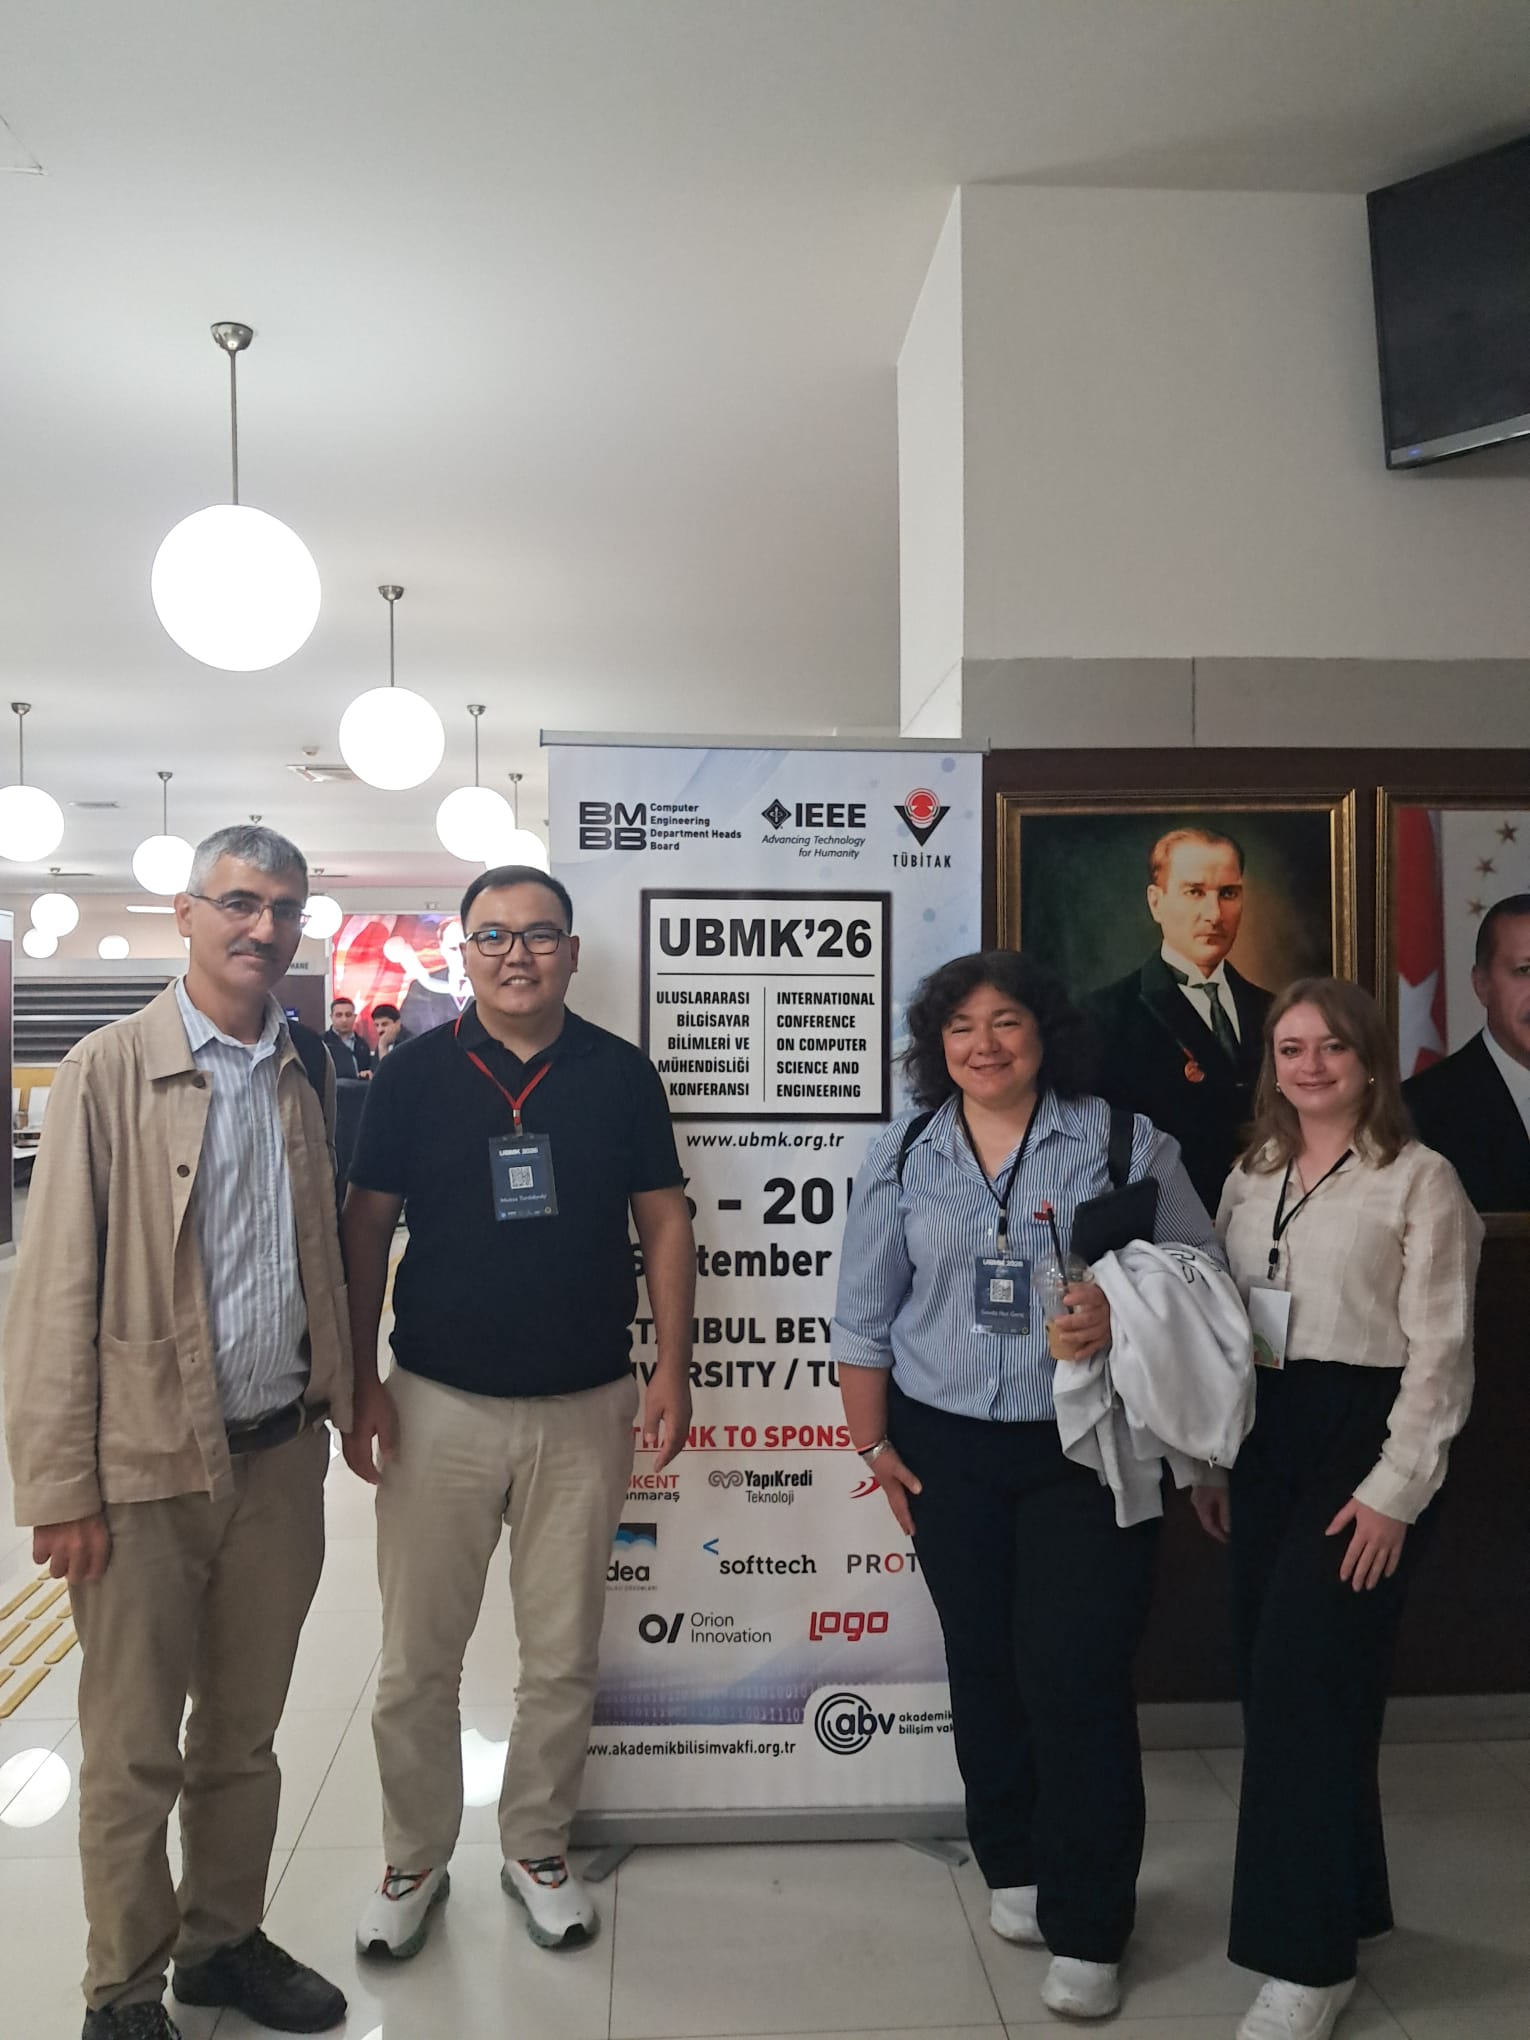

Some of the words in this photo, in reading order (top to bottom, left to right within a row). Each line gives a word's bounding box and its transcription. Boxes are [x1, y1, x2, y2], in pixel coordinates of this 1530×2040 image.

[578, 801, 647, 826] BM
[650, 803, 699, 814] Computer
[795, 803, 867, 828] IEEE
[650, 816, 710, 827] Engineering
[578, 827, 647, 850] BB
[650, 829, 709, 840] Department
[711, 830, 742, 839] Heads
[761, 835, 811, 847] Advancing
[814, 836, 866, 847] Technology
[650, 842, 680, 851] Board
[798, 848, 812, 859] for
[814, 849, 860, 860] Humanity
[892, 852, 951, 868] TÜBİTAK
[656, 991, 750, 1004] ULUSLARARASI
[777, 992, 875, 1005] INTERNATIONAL
[677, 1011, 750, 1027] BİLGİSAYAR
[777, 1015, 856, 1028] CONFERENCE
[668, 1034, 731, 1050] BİLİMLERİ
[735, 1037, 750, 1050] VE
[777, 1038, 795, 1051] ON
[799, 1038, 867, 1051] COMPUTER
[658, 1057, 750, 1073] MÜHENDİSLİĞİ
[777, 1061, 829, 1074] SCIENCE
[833, 1061, 859, 1074] AND
[670, 1083, 750, 1096] KONFERANSI
[777, 1084, 861, 1098] ENGINEERING
[686, 1132, 844, 1151] www.ubmk.org.tr
[763, 1177, 834, 1224] 20
[631, 1243, 832, 1277] Stember
[724, 1426, 756, 1447] TO
[628, 1474, 680, 1489] KENT
[745, 1490, 795, 1505] Teknoloji
[719, 1555, 817, 1575] softtech
[691, 1612, 734, 1627] Orion
[691, 1628, 772, 1643] Innovation
[899, 1723, 934, 1735] bilişim
